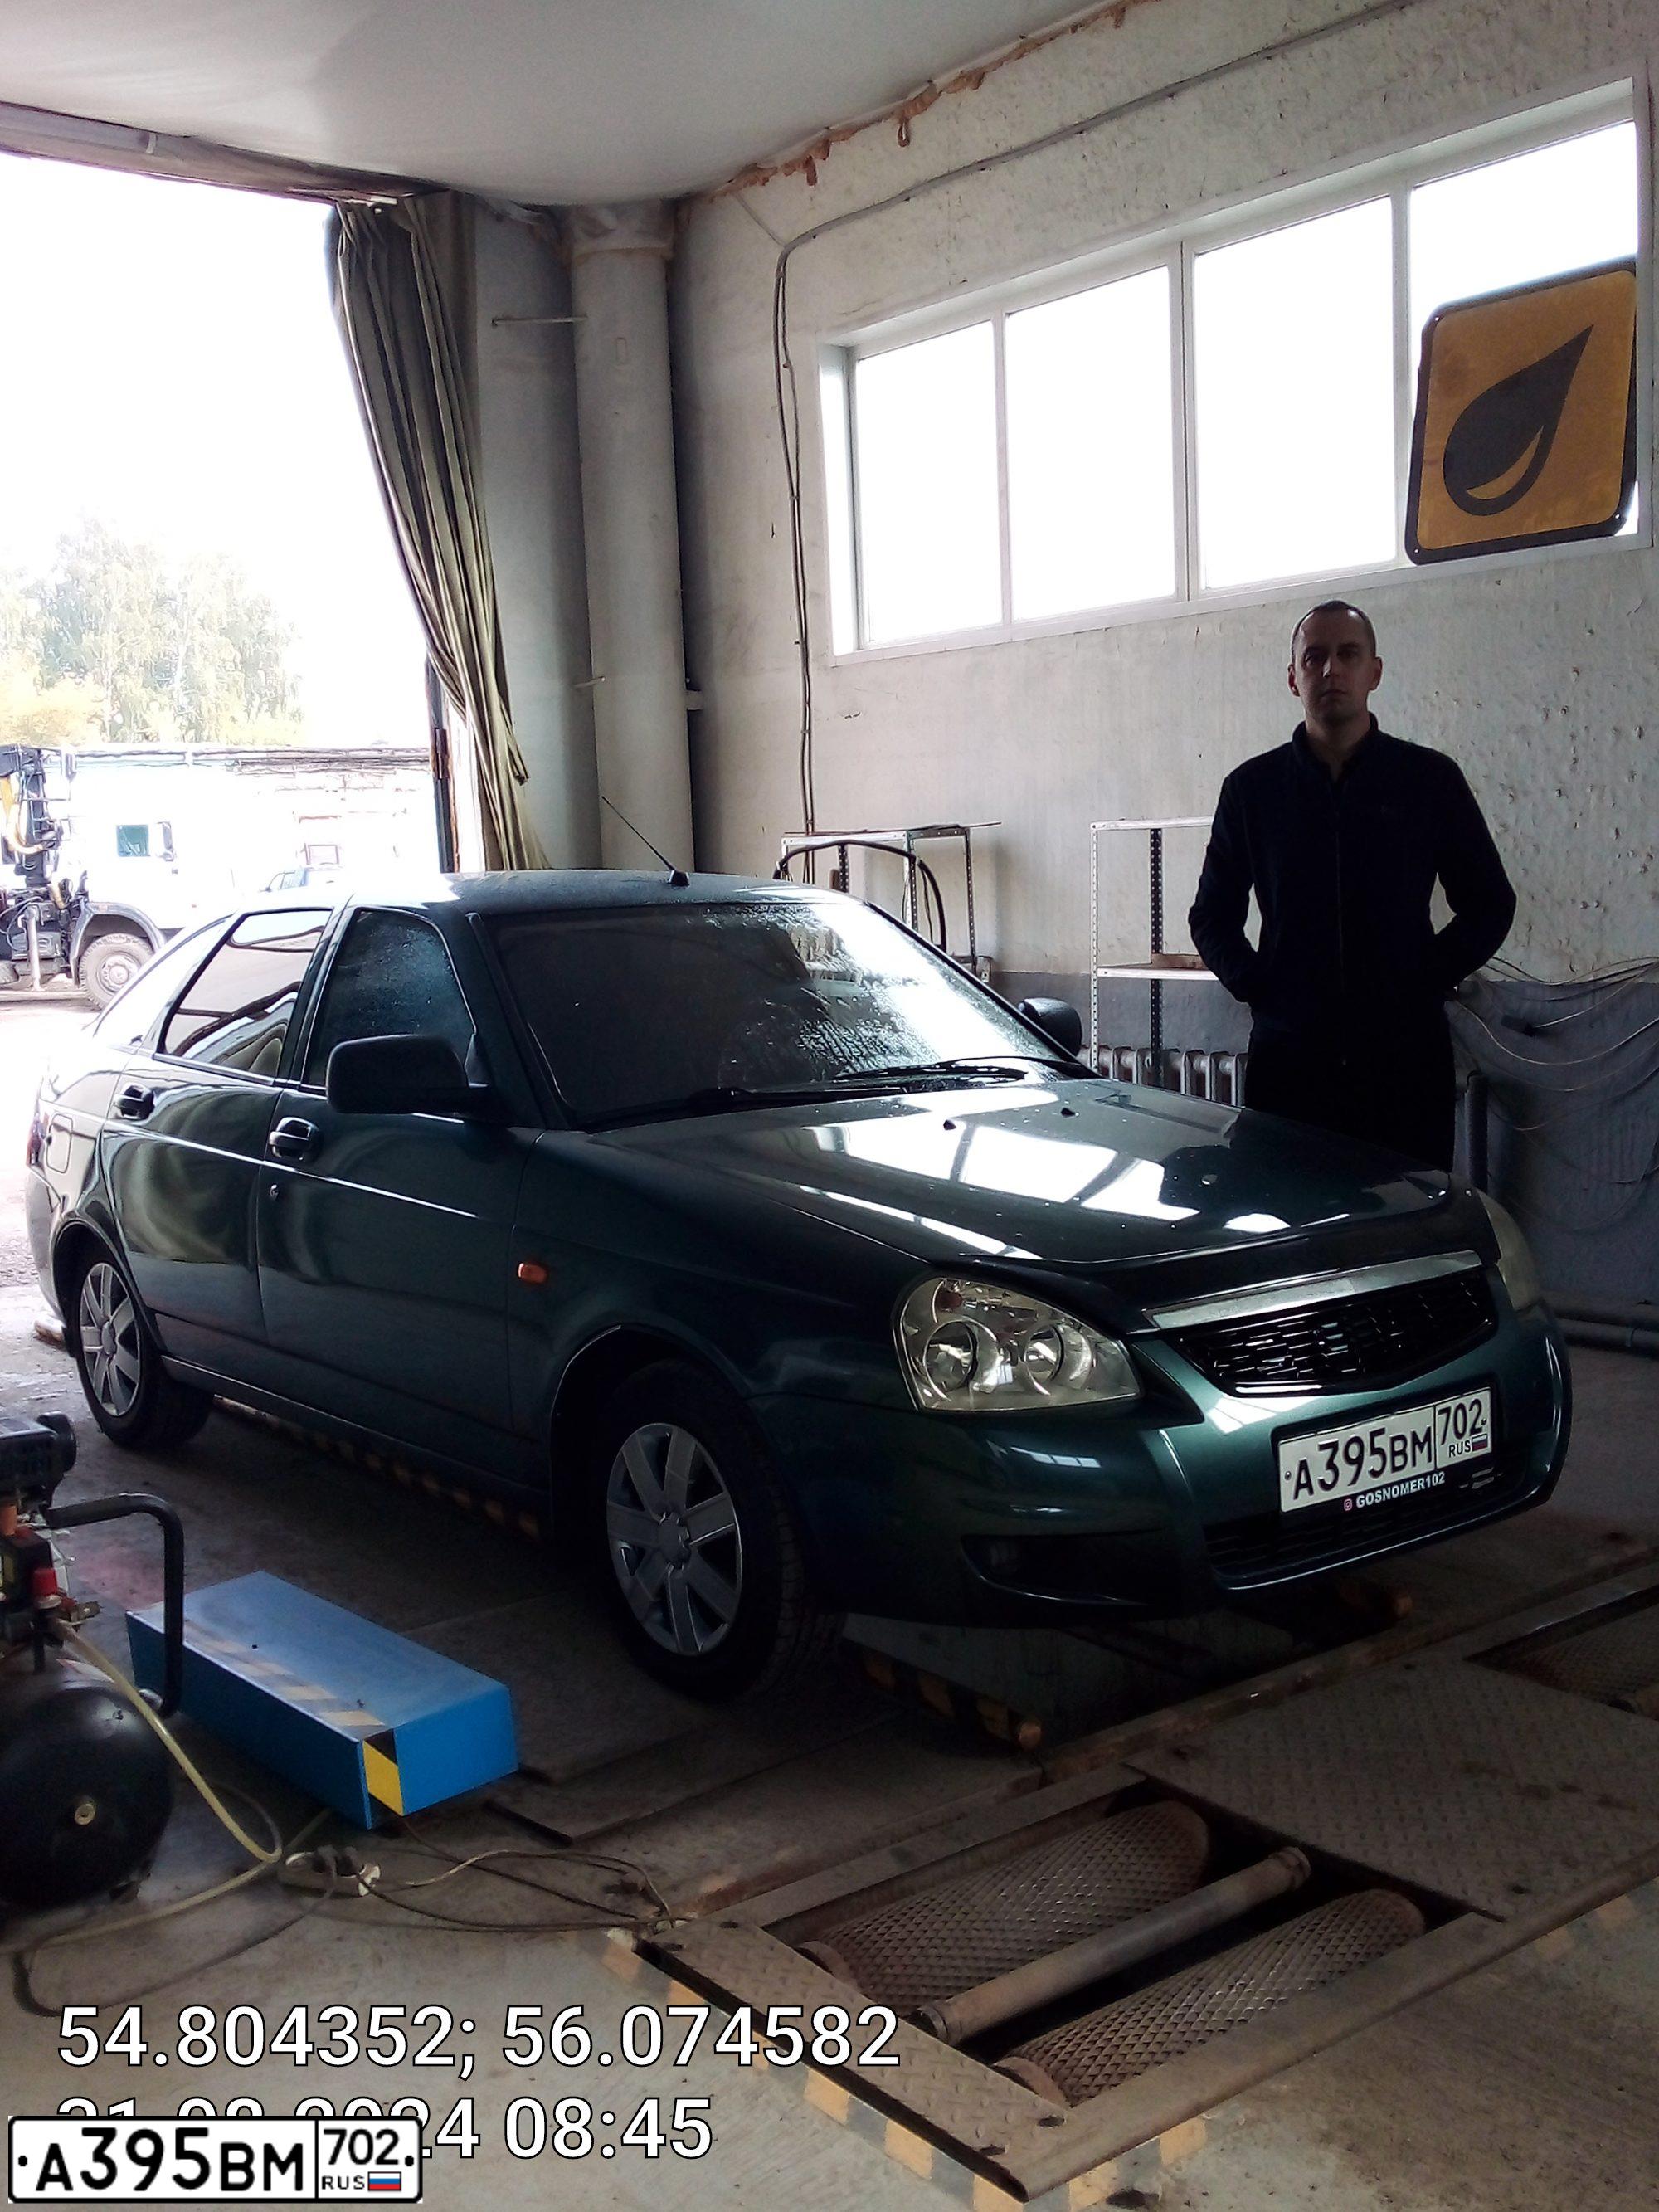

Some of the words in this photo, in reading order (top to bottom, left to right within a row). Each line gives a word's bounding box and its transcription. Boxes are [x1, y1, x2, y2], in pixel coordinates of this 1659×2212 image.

[1293, 1425, 1433, 1499] А395ВМ
[1438, 1399, 1483, 1445] 702
[1448, 1440, 1472, 1458] RUS
[1355, 1471, 1445, 1508] GOSNOMER102
